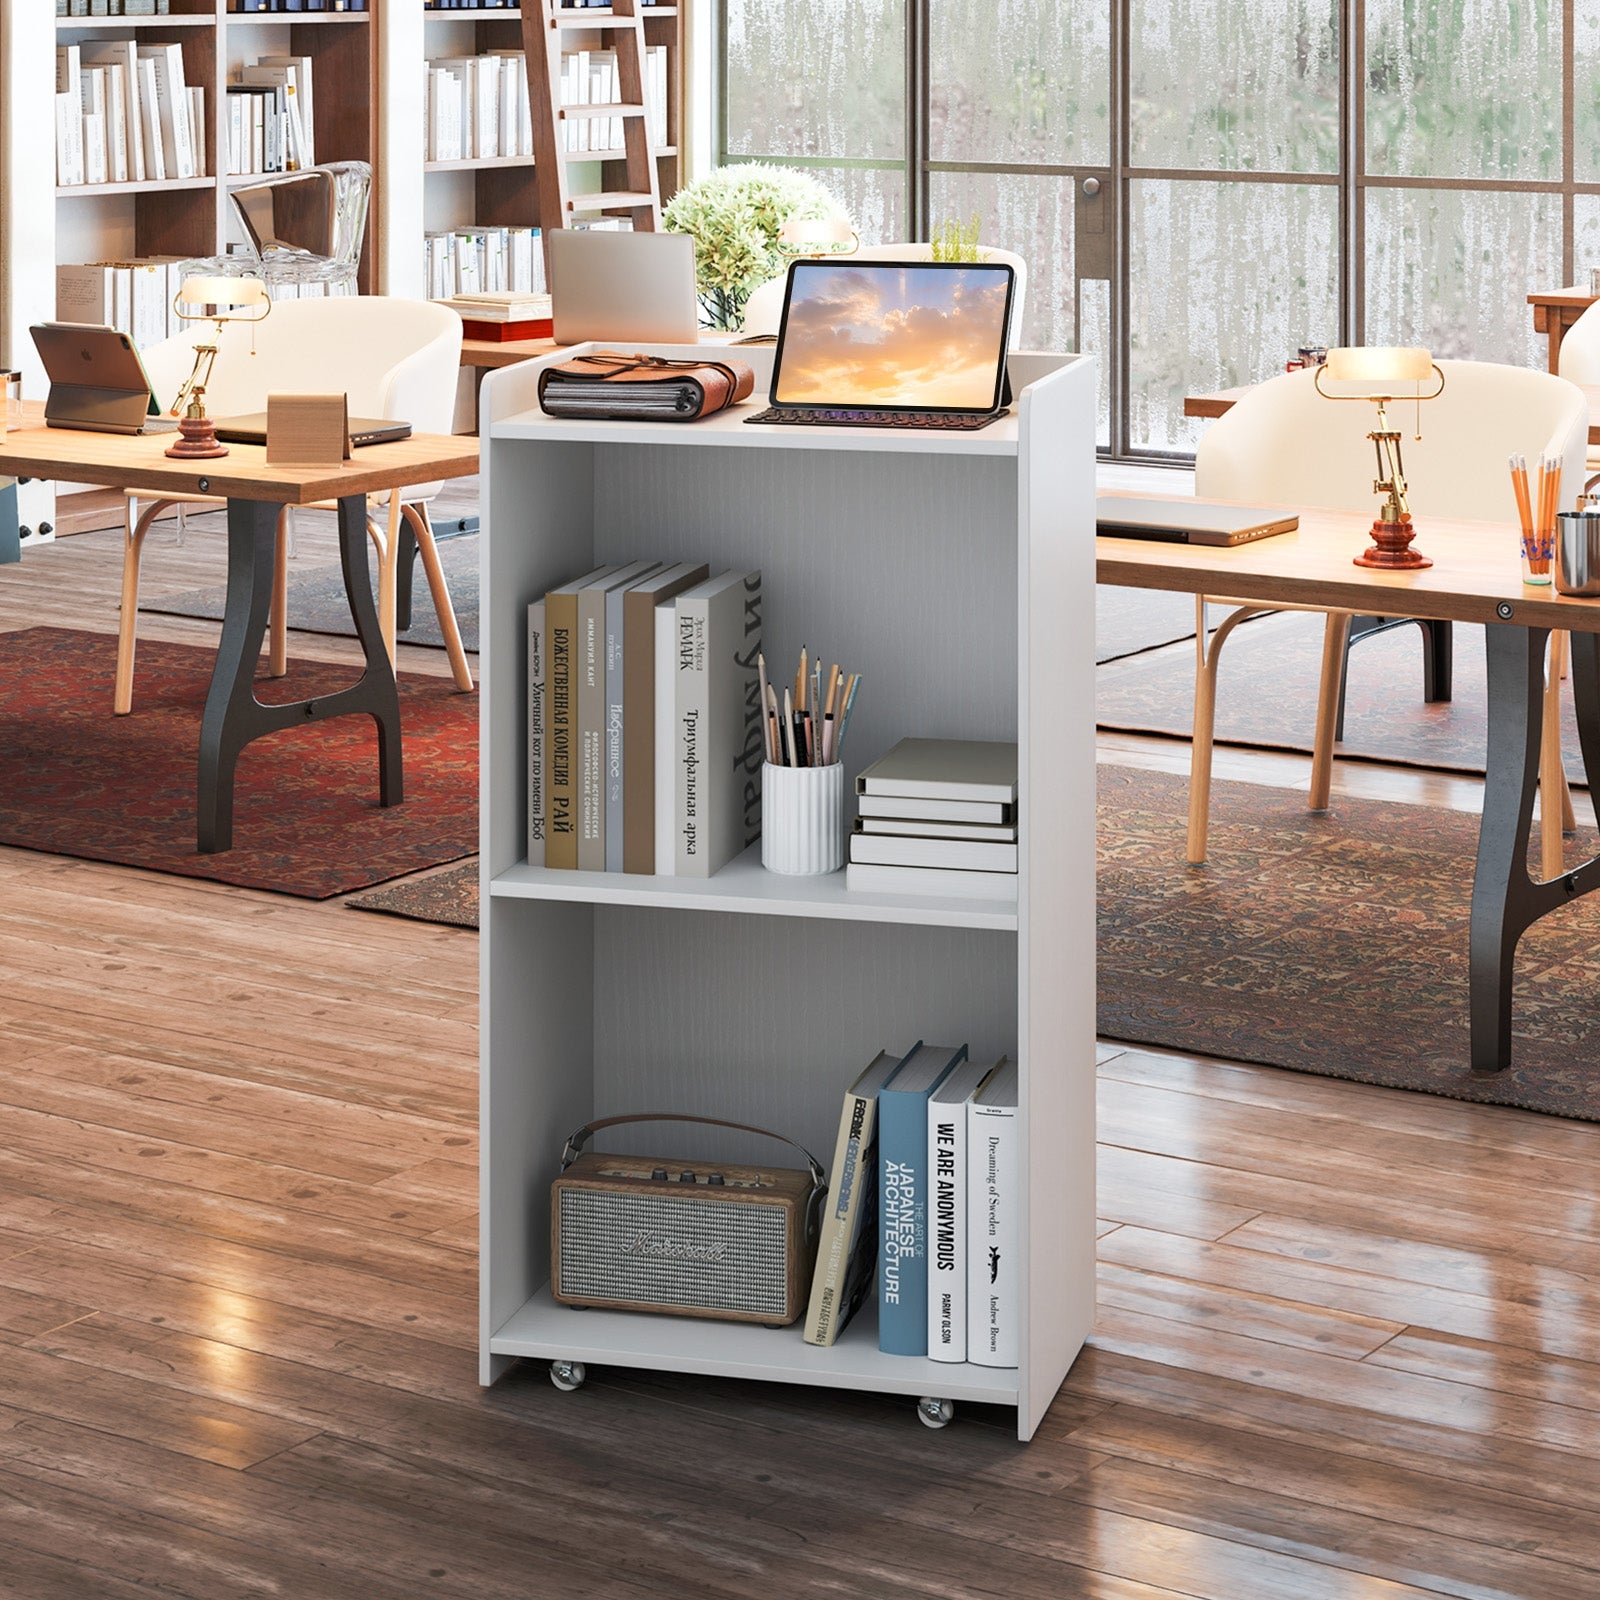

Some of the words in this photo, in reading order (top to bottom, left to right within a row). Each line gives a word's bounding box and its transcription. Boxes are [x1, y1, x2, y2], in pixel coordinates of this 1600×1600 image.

[587, 618, 595, 664] ИММАНУИЛ
[680, 616, 693, 671] РЕМАРК
[694, 617, 706, 639] Эрих
[553, 628, 569, 724] БОЖЕСТВЕННАЯ
[587, 666, 595, 686] КАНТ
[533, 682, 545, 734] Уличный
[533, 737, 542, 757] кот
[552, 728, 569, 786] КОМЕДИЯ
[607, 704, 623, 778] Избранное
[533, 760, 541, 775] по
[683, 709, 700, 817] Триумфальная
[533, 777, 541, 815] имени
[533, 817, 545, 840] Боб
[553, 796, 574, 834] РАЙ
[683, 822, 697, 855] арка
[937, 1123, 954, 1145] WE
[937, 1148, 954, 1177] ARE
[985, 1136, 1000, 1184] Dreaming
[989, 1186, 1000, 1197] of
[899, 1162, 914, 1258] JAPANESE
[915, 1201, 923, 1220] THE
[937, 1180, 954, 1271] ANONYMOUS
[989, 1198, 1000, 1236] Sweden
[621, 1229, 727, 1261] Marshall
[885, 1160, 899, 1304] ARCHITECTURE
[915, 1223, 923, 1242] ART
[915, 1244, 924, 1258] OF
[942, 1293, 951, 1319] PARMY
[989, 1295, 999, 1325] Andrew
[942, 1320, 951, 1344] OLSON
[989, 1327, 999, 1352] Brown
